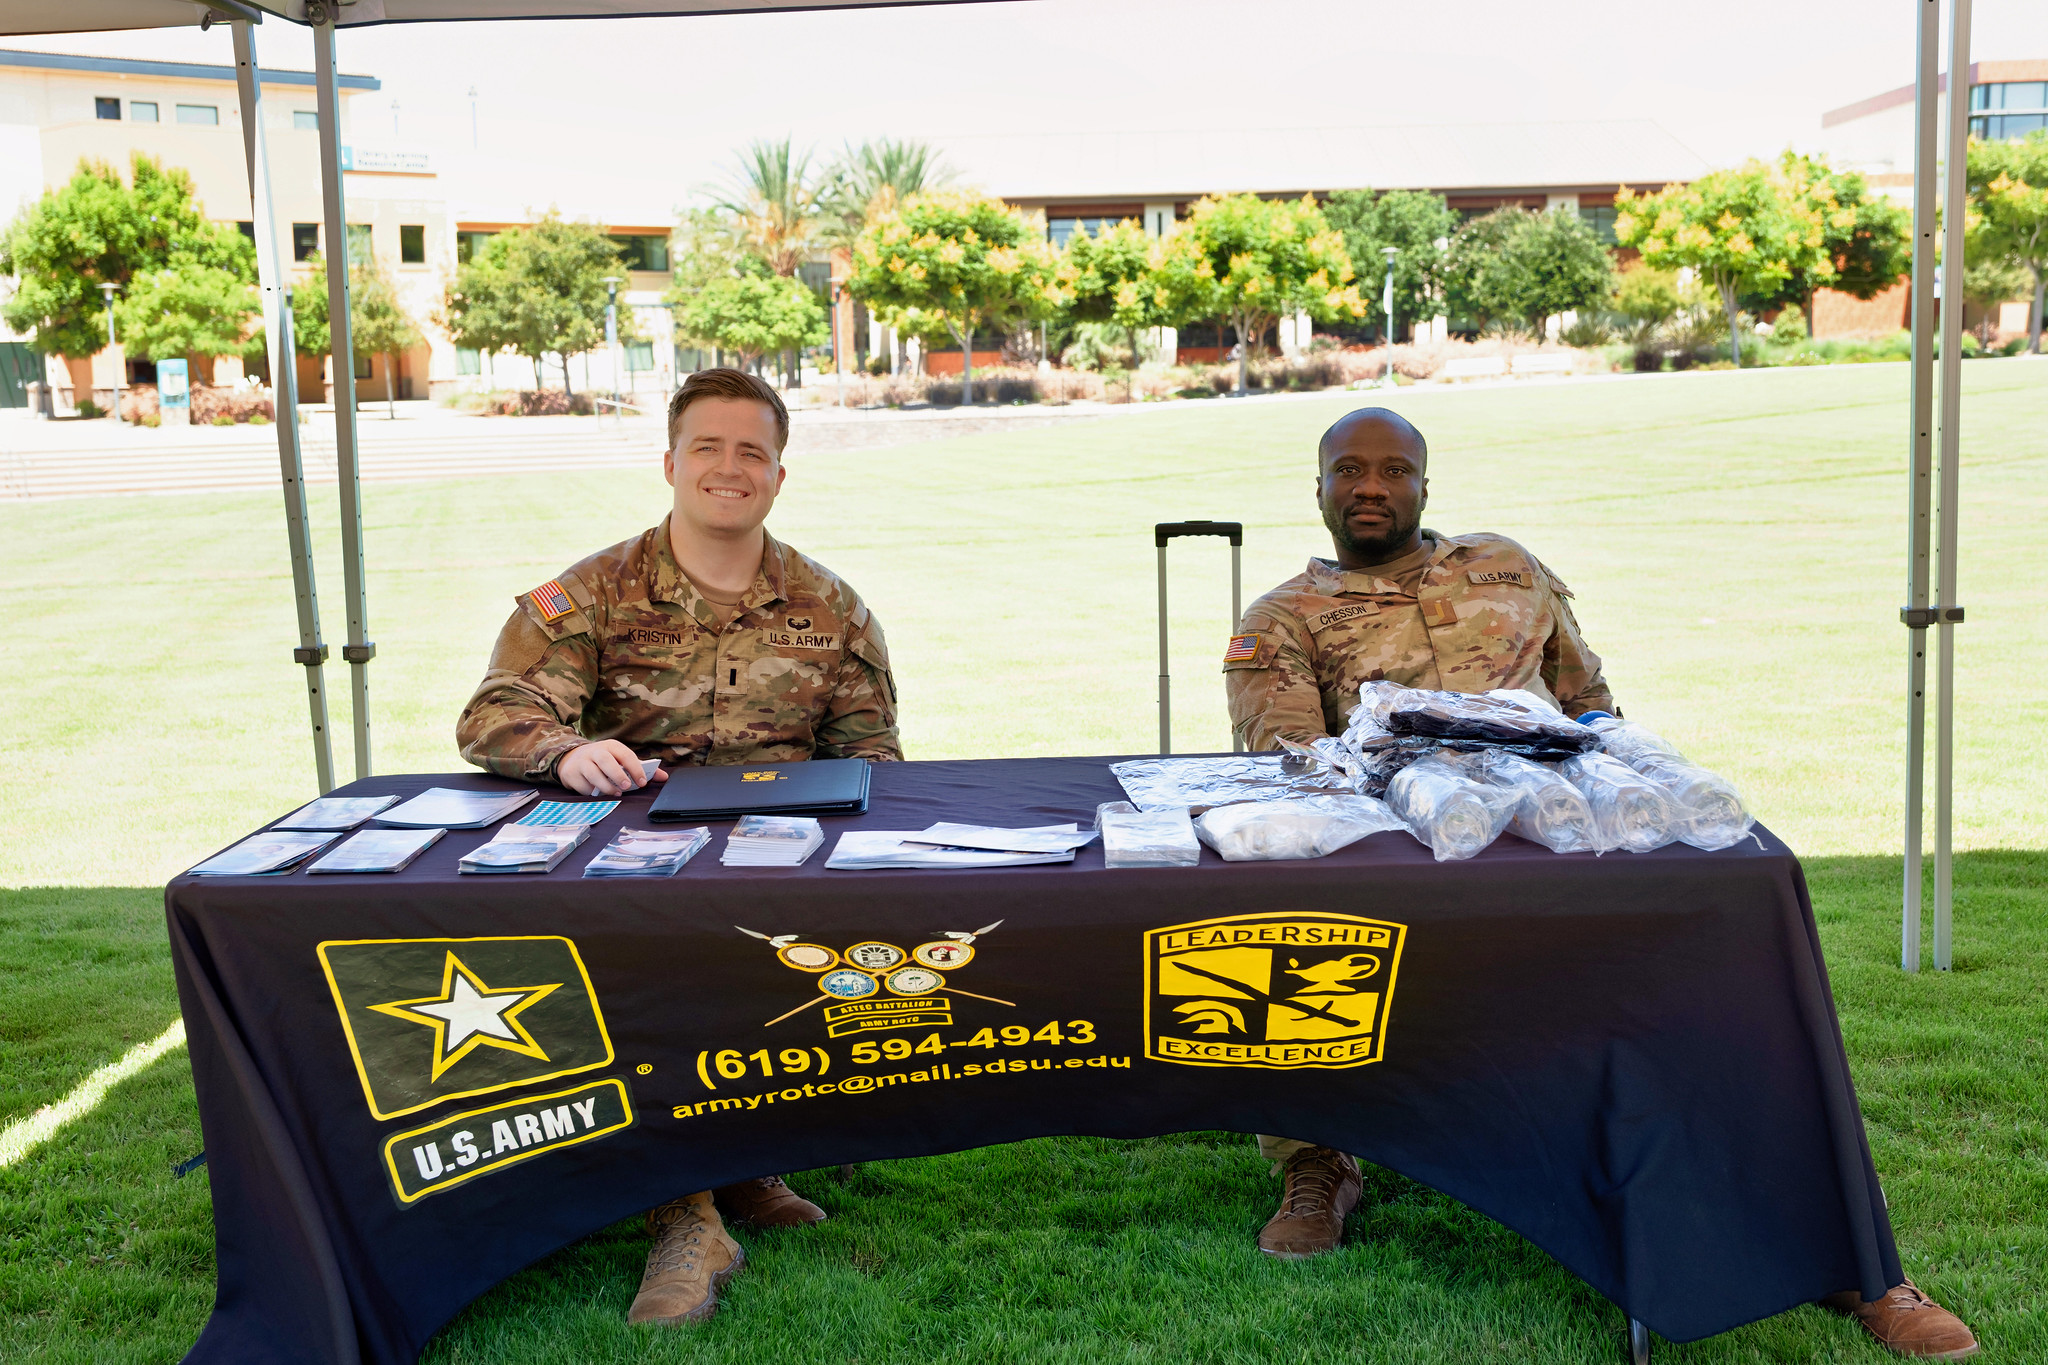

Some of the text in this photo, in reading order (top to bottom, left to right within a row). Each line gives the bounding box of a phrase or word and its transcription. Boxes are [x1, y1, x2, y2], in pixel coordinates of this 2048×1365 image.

[1319, 605, 1368, 626] CHESSON
[627, 627, 682, 645] KRISTIN
[1166, 925, 1386, 949] LEADERSHIP
[840, 1000, 933, 1014] AZTEC BATTALION
[860, 1016, 920, 1028] ARMY ROTC
[696, 1019, 1097, 1090] (619) 594-4943
[1166, 1040, 1367, 1062] EXCELLENCE
[672, 1055, 1131, 1119] armyrotc@mail.sdsu.edu
